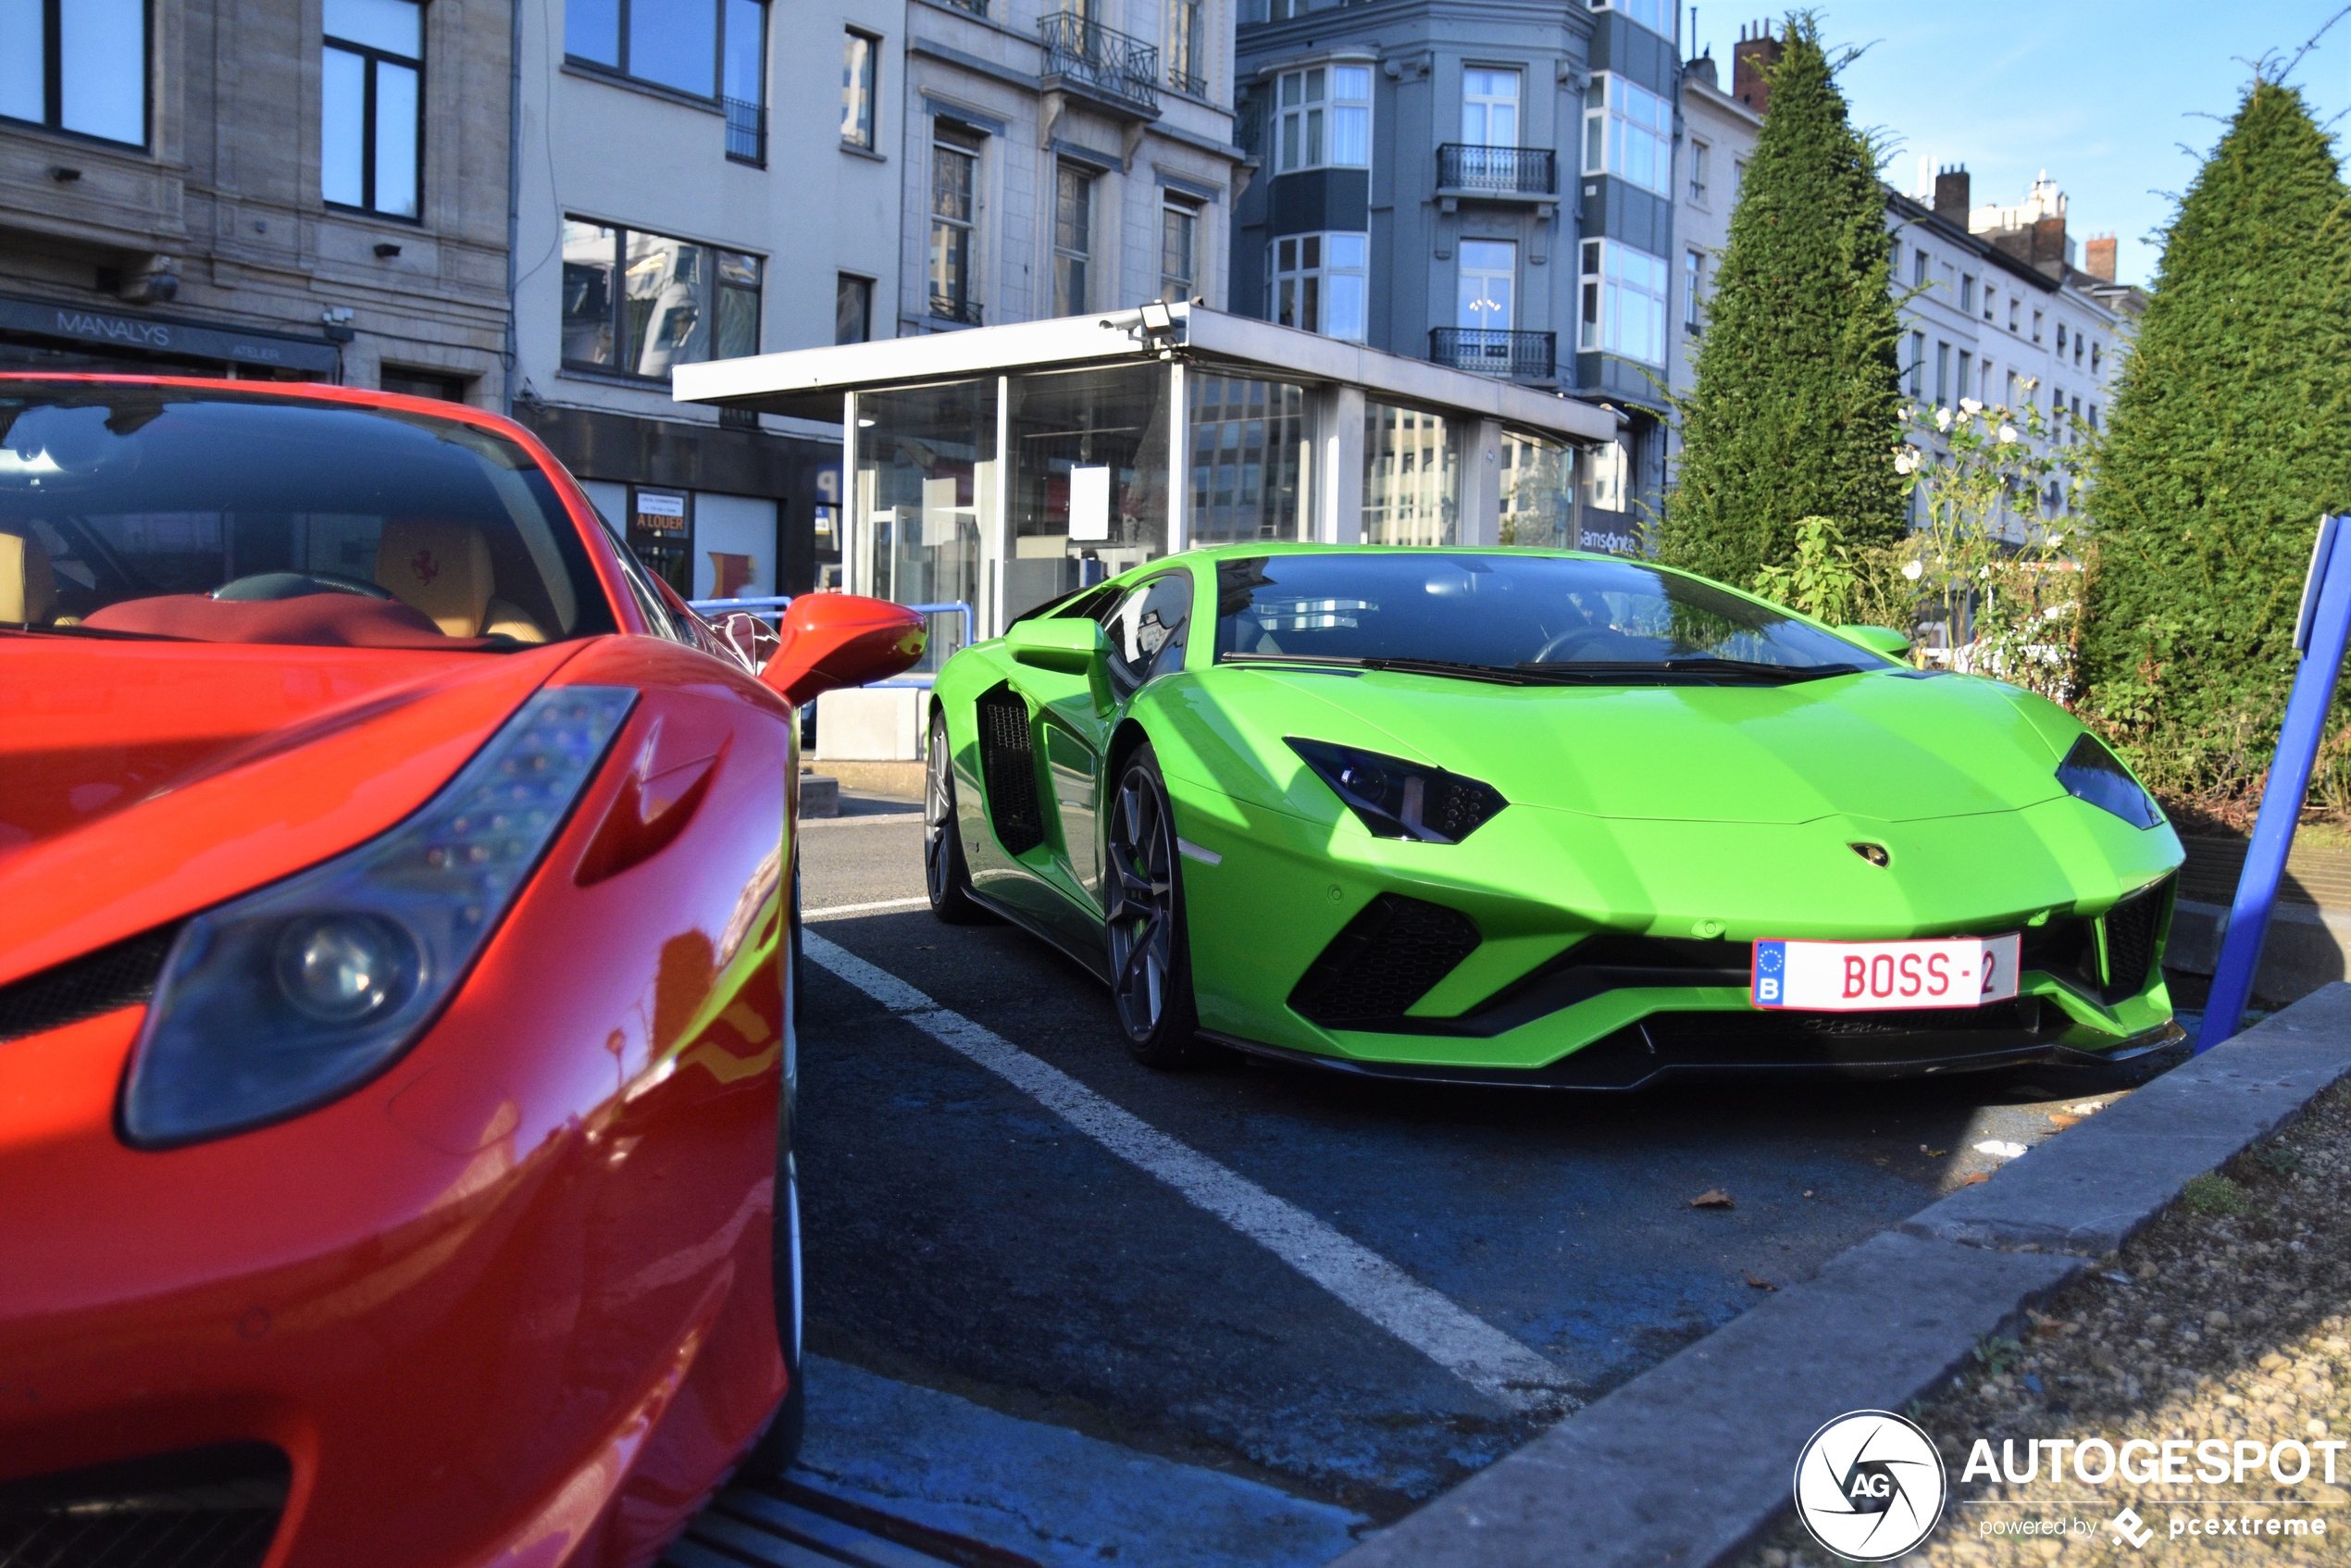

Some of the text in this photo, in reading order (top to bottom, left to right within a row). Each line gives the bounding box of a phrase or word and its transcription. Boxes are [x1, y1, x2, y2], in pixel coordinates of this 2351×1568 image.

[57, 311, 169, 346] MANALYS
[637, 514, 683, 529] A LOUER
[1760, 978, 1779, 1000] B
